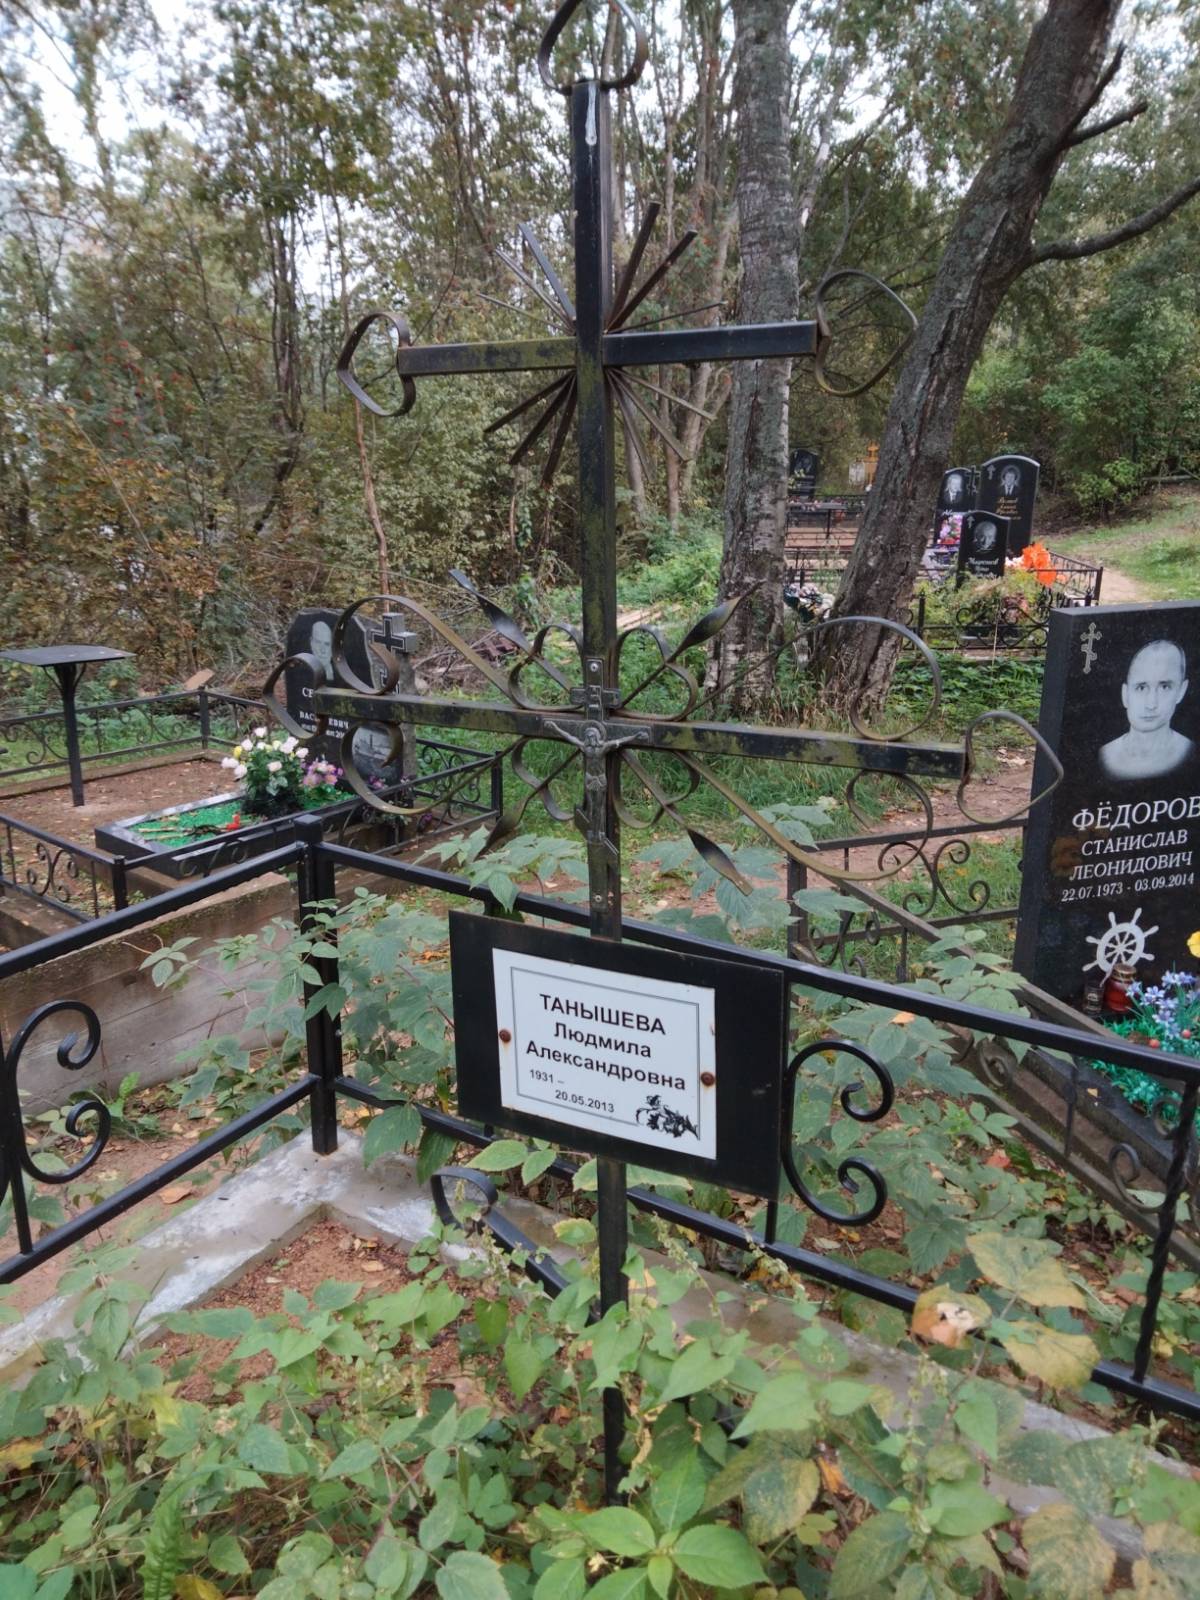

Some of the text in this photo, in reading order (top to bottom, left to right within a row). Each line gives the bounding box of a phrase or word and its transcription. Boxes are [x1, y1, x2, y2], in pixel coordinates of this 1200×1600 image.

[1072, 795, 1200, 831] ФЁДОРОВ
[1081, 828, 1188, 856] СТАНИСЛАВ
[1069, 851, 1193, 881] ЛЕОНИДОВИЧ
[1061, 882, 1123, 902] 22.07.1973
[1134, 872, 1194, 892] 03.09.2014
[539, 993, 666, 1035] ТАНЫШЕВА
[553, 1022, 652, 1058] Людмила
[525, 1040, 686, 1091] Александровна
[530, 1069, 554, 1084] 1931
[554, 1089, 615, 1113] 20.05.2013
